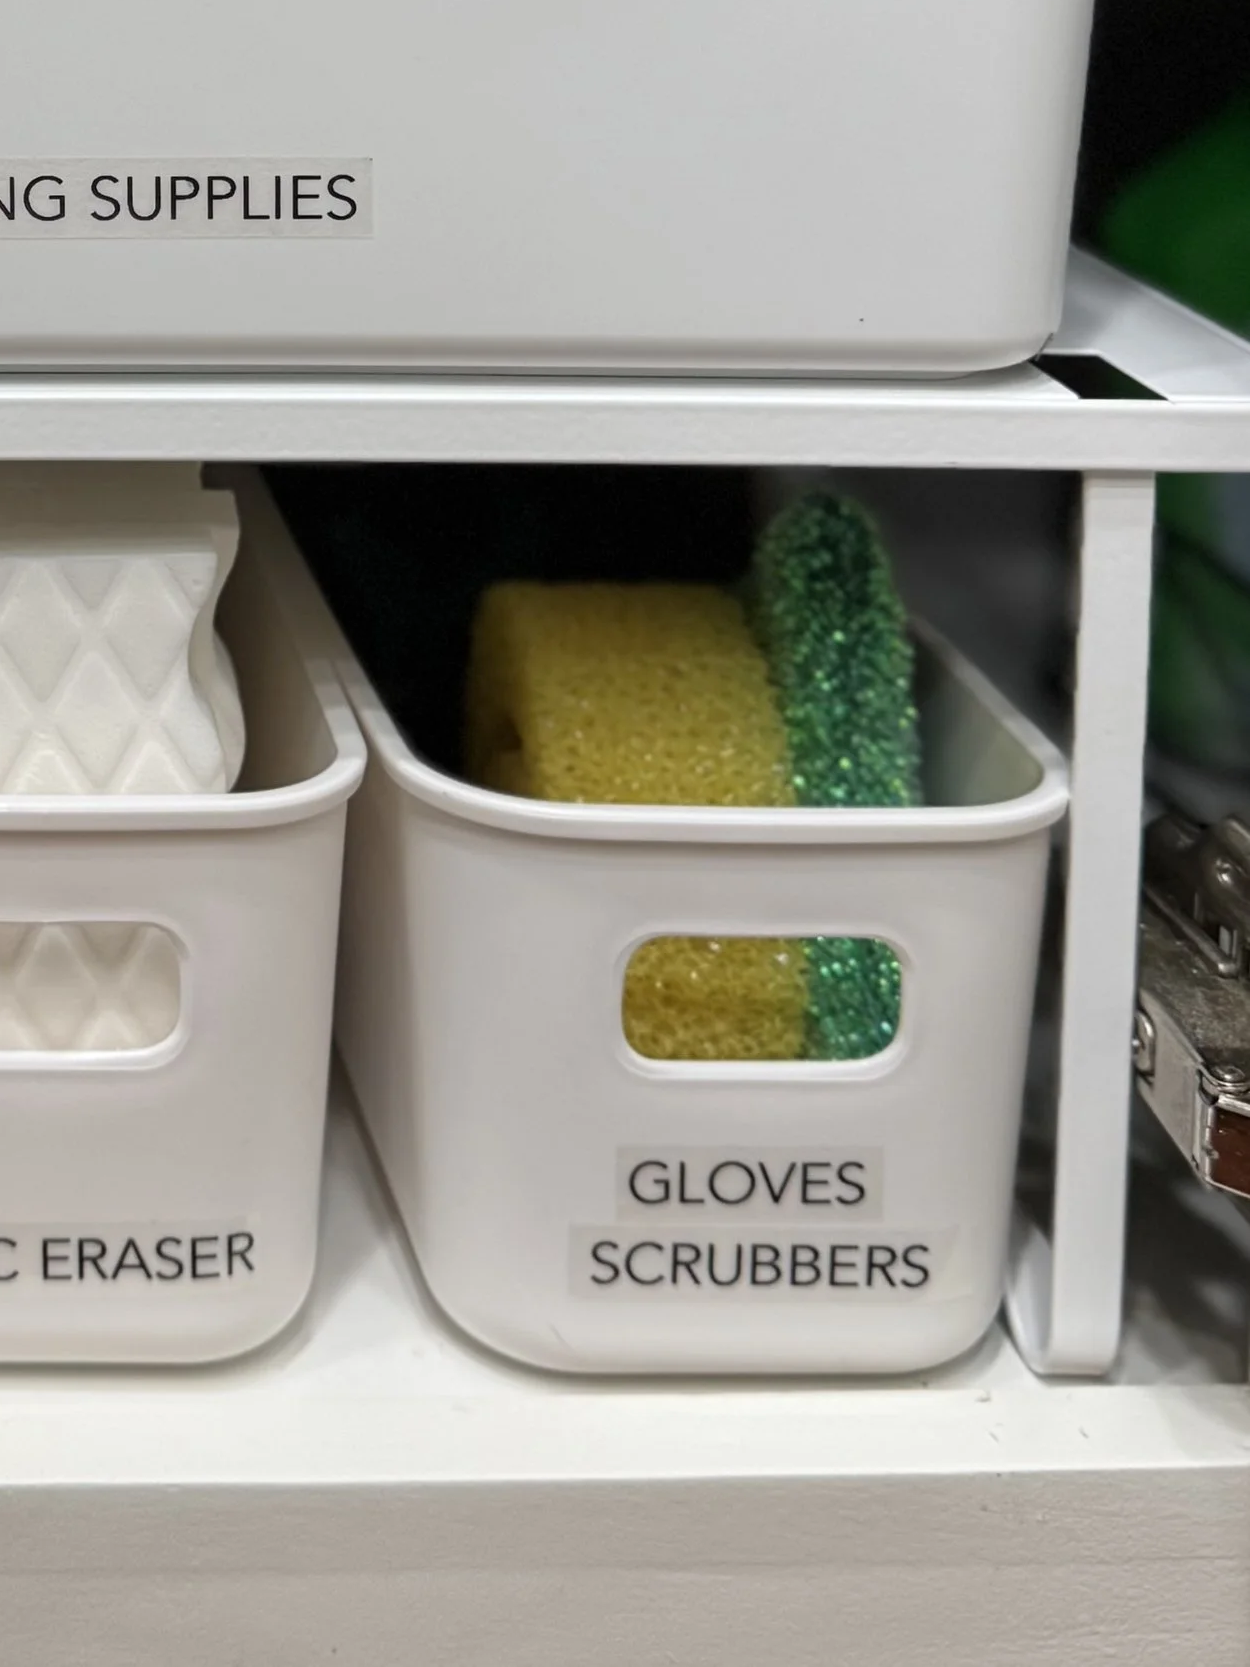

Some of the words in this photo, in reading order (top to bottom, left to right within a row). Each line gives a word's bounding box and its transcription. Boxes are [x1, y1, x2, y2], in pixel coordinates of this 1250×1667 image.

[90, 174, 359, 222] SUPPLIES
[629, 1159, 866, 1206] GLOVES
[42, 1232, 255, 1281] ERASER
[590, 1240, 930, 1289] SCRUBBERS
